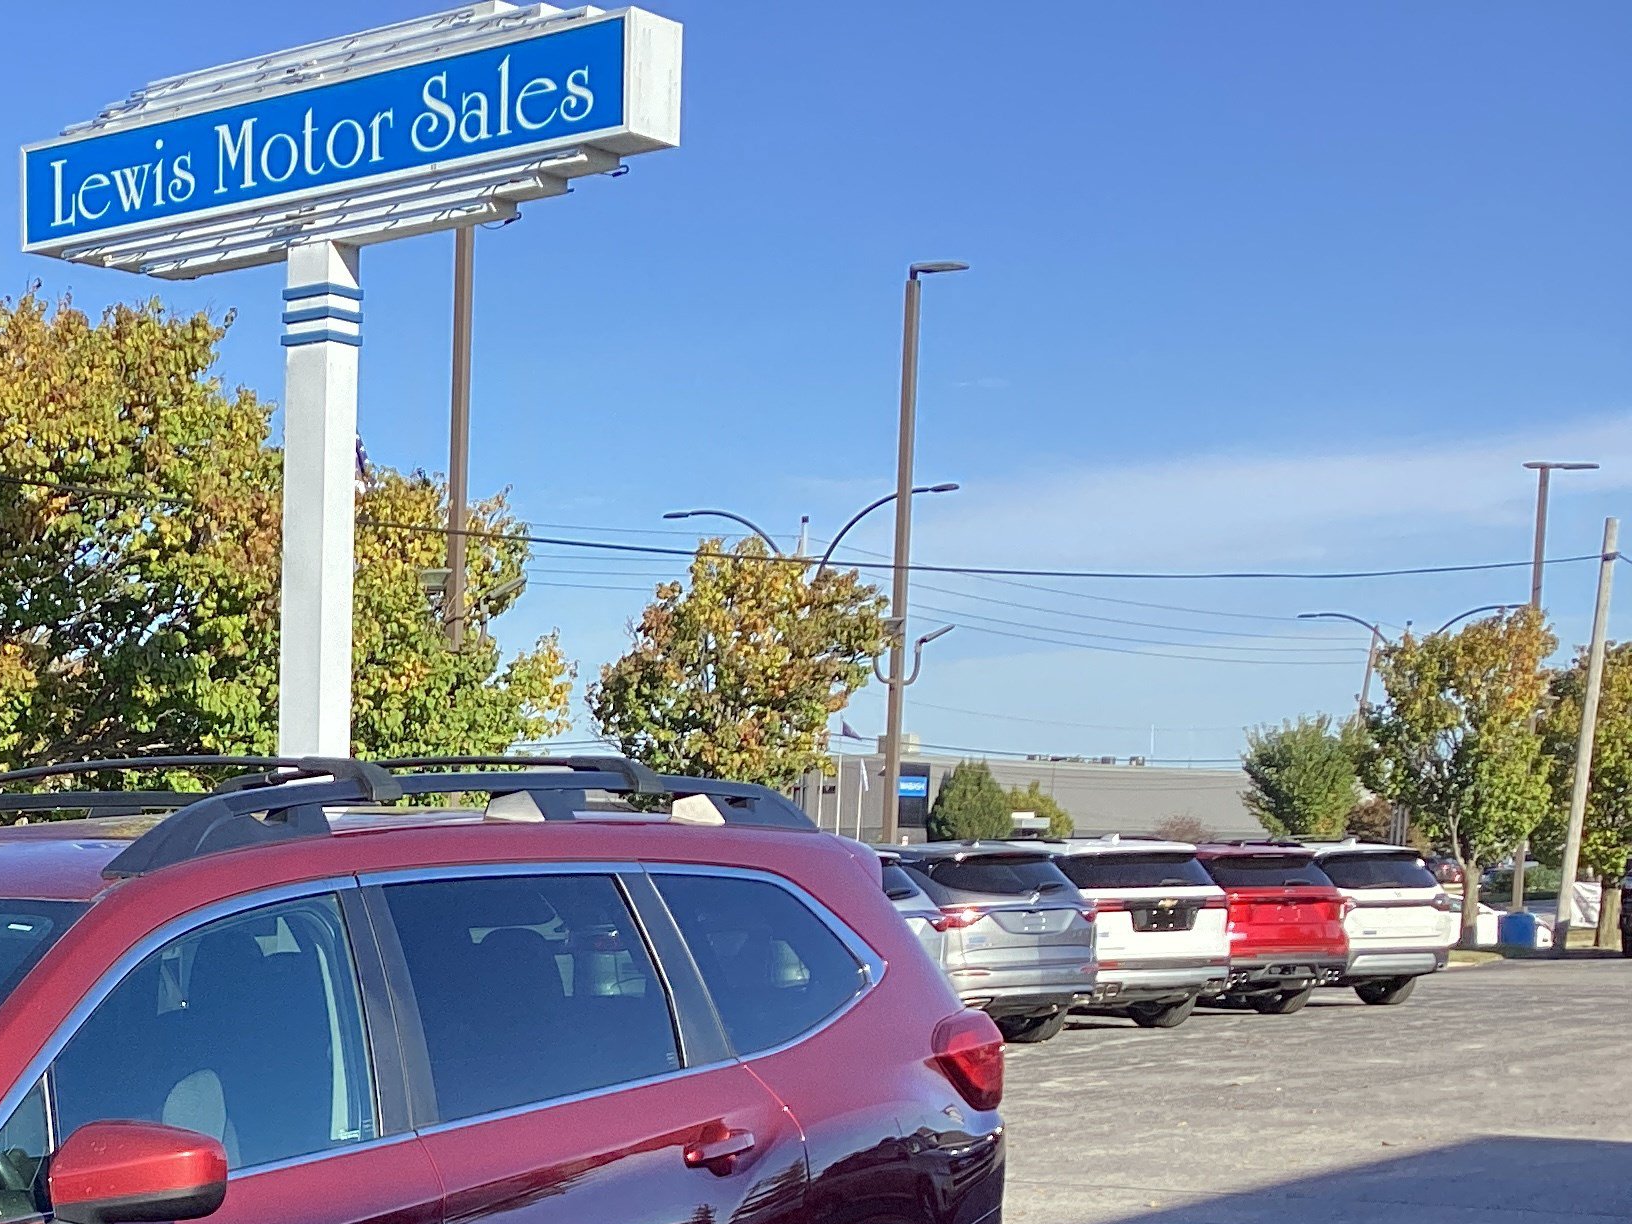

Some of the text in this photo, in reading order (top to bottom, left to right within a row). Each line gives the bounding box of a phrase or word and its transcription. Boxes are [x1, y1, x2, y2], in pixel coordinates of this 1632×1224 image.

[50, 54, 594, 227] Lewis Motor Sales
